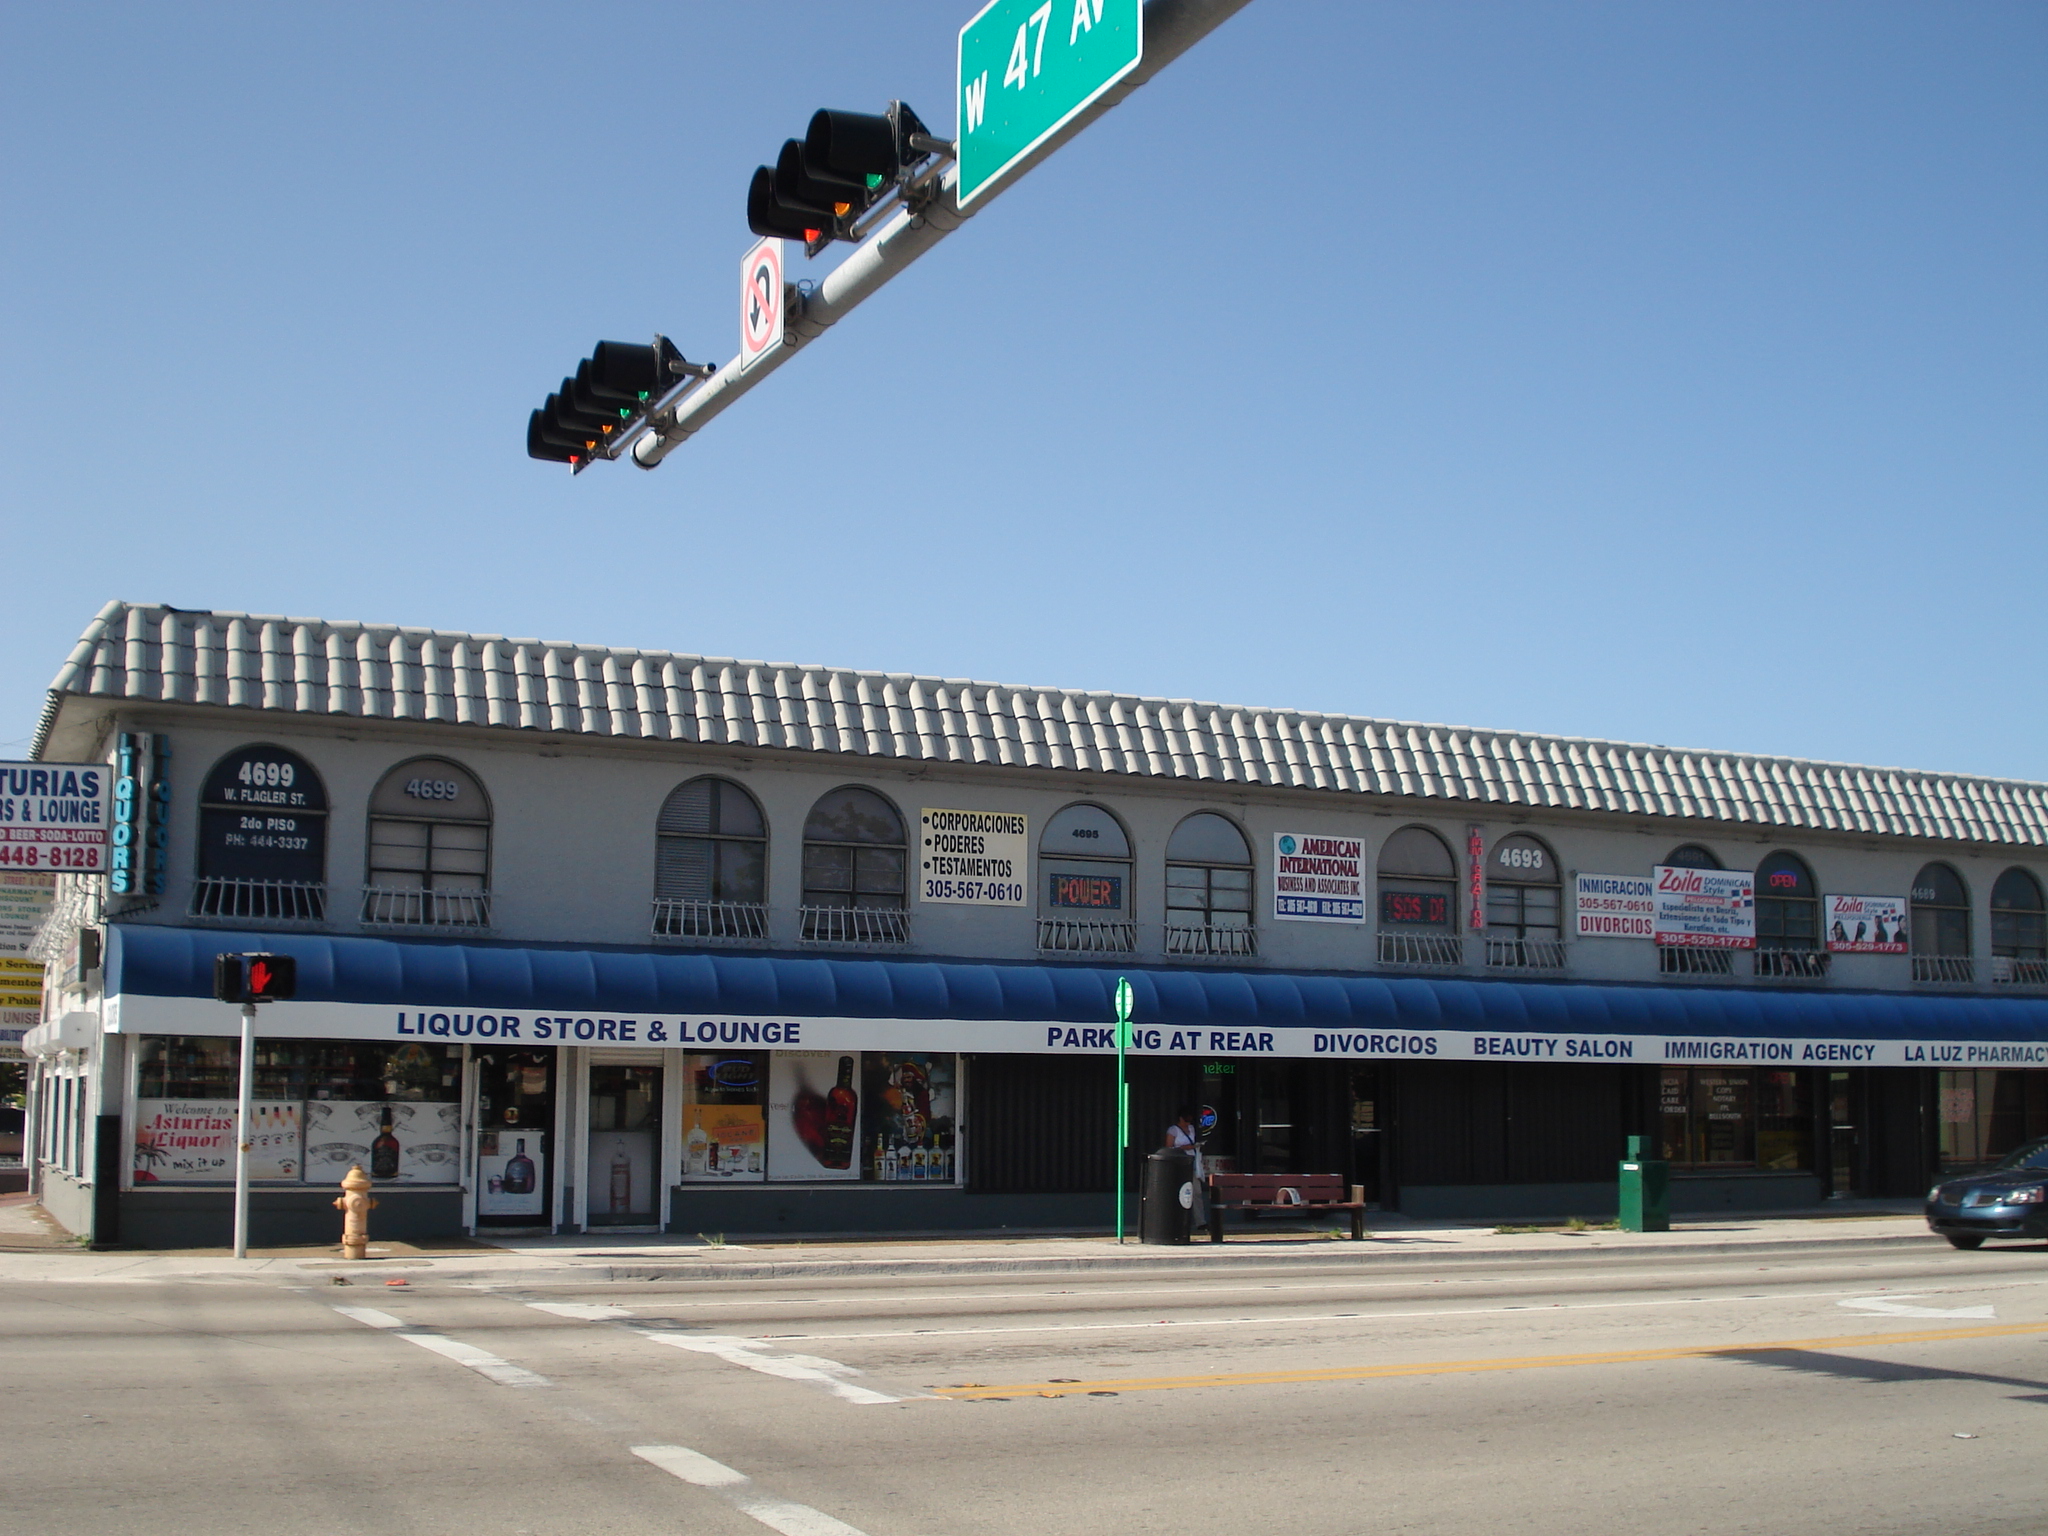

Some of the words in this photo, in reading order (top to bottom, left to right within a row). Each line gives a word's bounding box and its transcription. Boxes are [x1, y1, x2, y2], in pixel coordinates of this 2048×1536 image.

[965, 69, 988, 134] W
[1003, 0, 1052, 91] 47
[238, 761, 294, 787] 4699
[224, 788, 237, 801] W.
[240, 788, 287, 804] FLAGLER
[290, 792, 306, 805] ST.
[406, 777, 459, 800] 4699
[21, 799, 31, 821] &
[39, 799, 100, 823] LOUNGE
[112, 732, 138, 893] LIQUORS
[151, 734, 172, 895] LIQUORS
[240, 816, 263, 830] 2do
[267, 818, 296, 831] PISO
[931, 812, 1025, 835] CORPORACIONES
[934, 836, 985, 855] PODERES
[1302, 838, 1361, 859] AMERICAN
[931, 856, 1012, 878] TESTAMENTOS
[1279, 856, 1360, 877] INTERNATIONAL
[1500, 848, 1543, 869] 4693
[925, 880, 1023, 901] 305-567-0610
[1058, 877, 1111, 905] POWER
[1278, 876, 1303, 892] BUSINESS
[1304, 877, 1316, 892] AND
[1317, 878, 1349, 894] ASSOCIATES
[1579, 878, 1653, 897] INMIGRACION
[1659, 869, 1702, 893] Zoila
[1703, 886, 1725, 896] Style
[1704, 876, 1751, 888] DOMINICAN
[1770, 874, 1797, 888] OPEN
[1579, 897, 1654, 912] 305-567-0610
[1834, 896, 1863, 913] Zoila
[1581, 915, 1653, 934] DIVORCIOS
[1661, 933, 1751, 947] 305-529-1773
[397, 1012, 521, 1038] LIQUOR
[533, 1016, 636, 1041] STORE
[647, 1020, 668, 1042] &
[679, 1021, 801, 1044] LOUNGE
[1047, 1027, 1161, 1051] PARKNG
[1169, 1031, 1201, 1050] AT
[1210, 1032, 1274, 1052] REAR
[1314, 1033, 1438, 1055] DIVORCIOS
[1474, 1037, 1558, 1056] BEAUTY
[1565, 1039, 1633, 1058] SALON
[1665, 1042, 1793, 1060] IMMIGRATION
[1802, 1044, 1876, 1061] AGENCY
[1905, 1046, 1925, 1061] LA
[1931, 1046, 1962, 1062] LUZ
[164, 1104, 215, 1115] Welcome
[216, 1105, 228, 1115] to
[145, 1113, 232, 1130] Asturias
[156, 1131, 220, 1150] Liquor
[173, 1158, 194, 1170] mix
[197, 1157, 208, 1167] it
